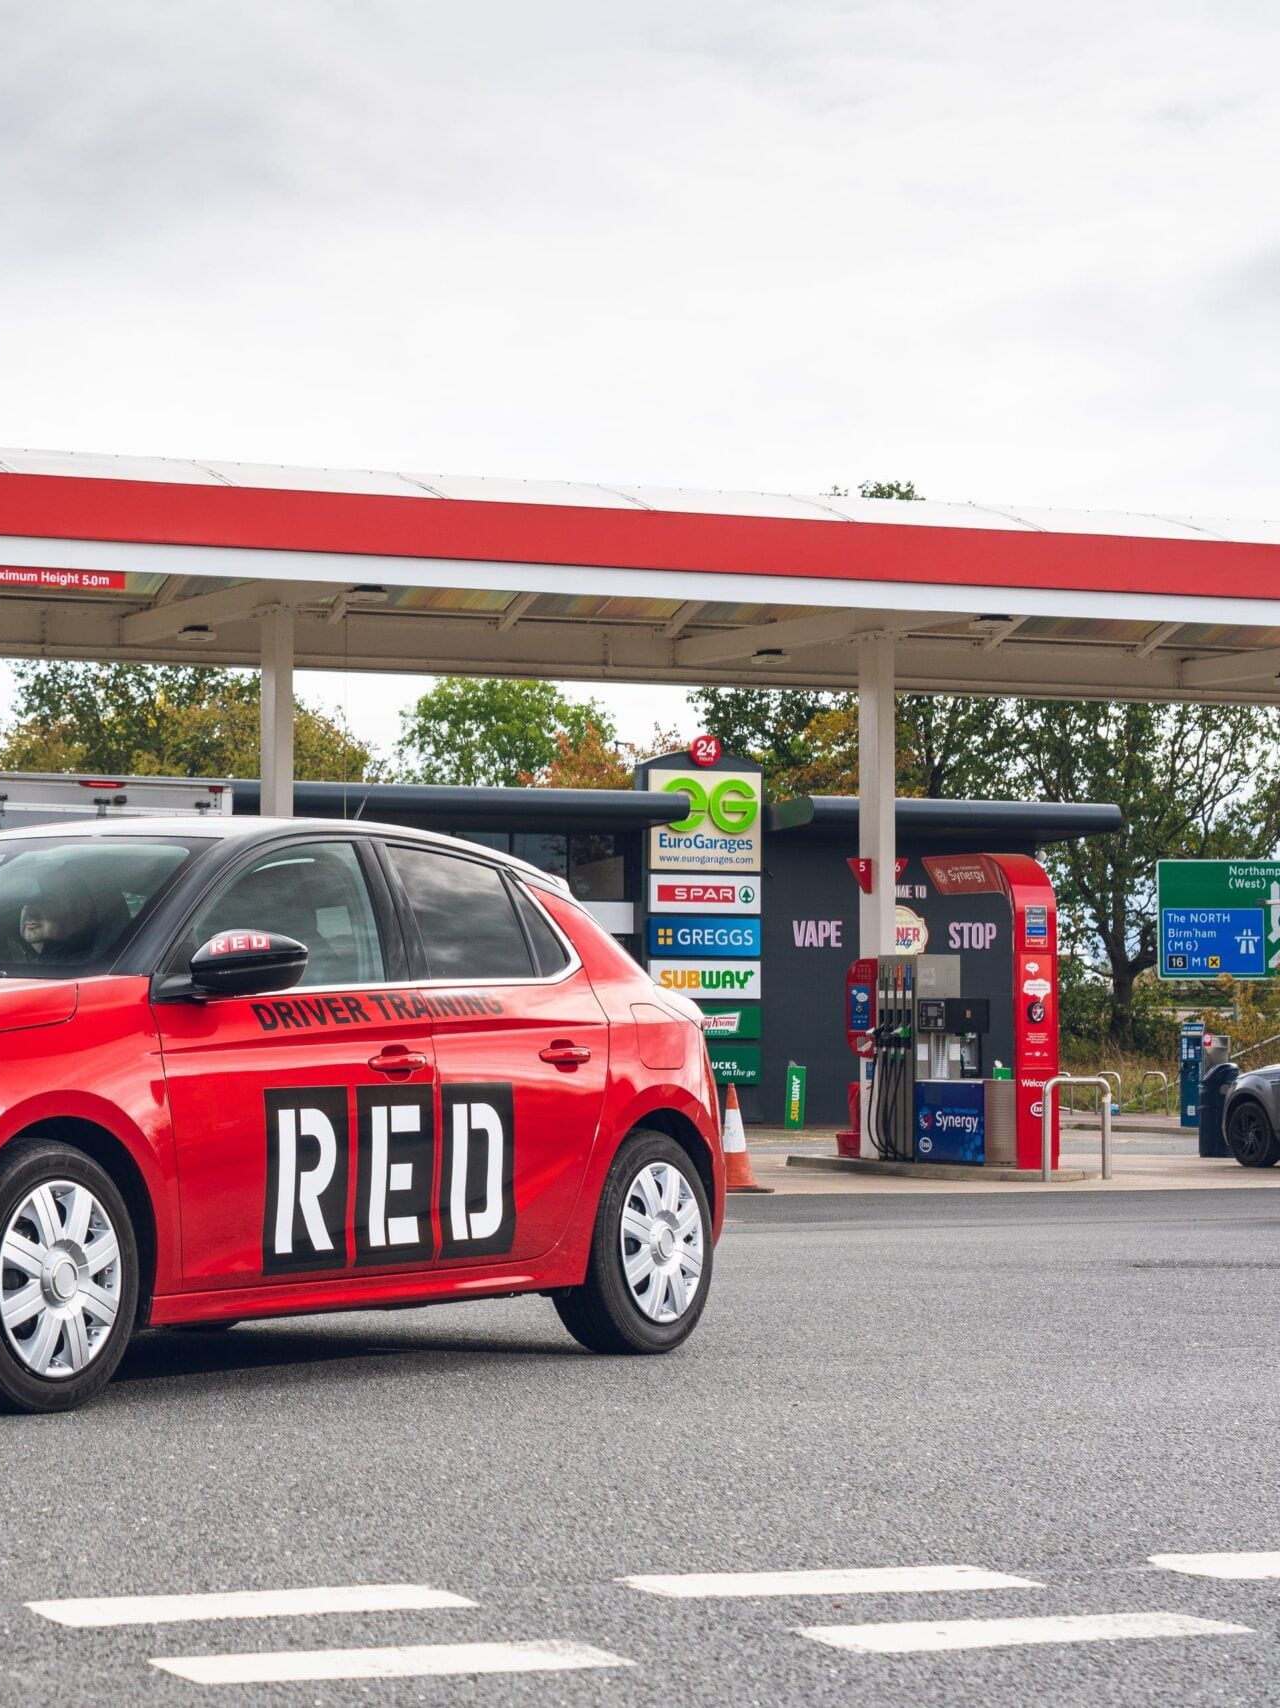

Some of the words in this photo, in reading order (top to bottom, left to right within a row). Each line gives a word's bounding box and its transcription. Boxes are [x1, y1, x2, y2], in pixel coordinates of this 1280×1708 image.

[41, 571, 79, 586] Height
[82, 575, 109, 586] 5.0m
[696, 740, 717, 756] 24
[658, 833, 753, 853] EuroGarages
[658, 854, 754, 865] www.eurogarages.com
[859, 861, 866, 872] 5
[947, 869, 986, 884] Synergy
[1228, 877, 1266, 889] (West)
[674, 888, 733, 900] SPAR
[914, 884, 927, 899] TO
[1167, 913, 1186, 923] The
[1190, 913, 1231, 923] NORTH
[677, 928, 754, 946] GREGGS
[792, 920, 843, 948] VAPE
[948, 922, 997, 949] STOP
[1168, 927, 1217, 938] Birm'ham
[211, 935, 268, 953] RED
[1171, 957, 1184, 967] 16
[657, 969, 755, 990] SUBWAY
[250, 997, 371, 1031] DRIVER
[368, 990, 504, 1020] TRAINING
[733, 1068, 745, 1076] the
[790, 1075, 801, 1122] SUBWAY
[935, 1111, 979, 1133] Synergy
[274, 1102, 505, 1255] RED
